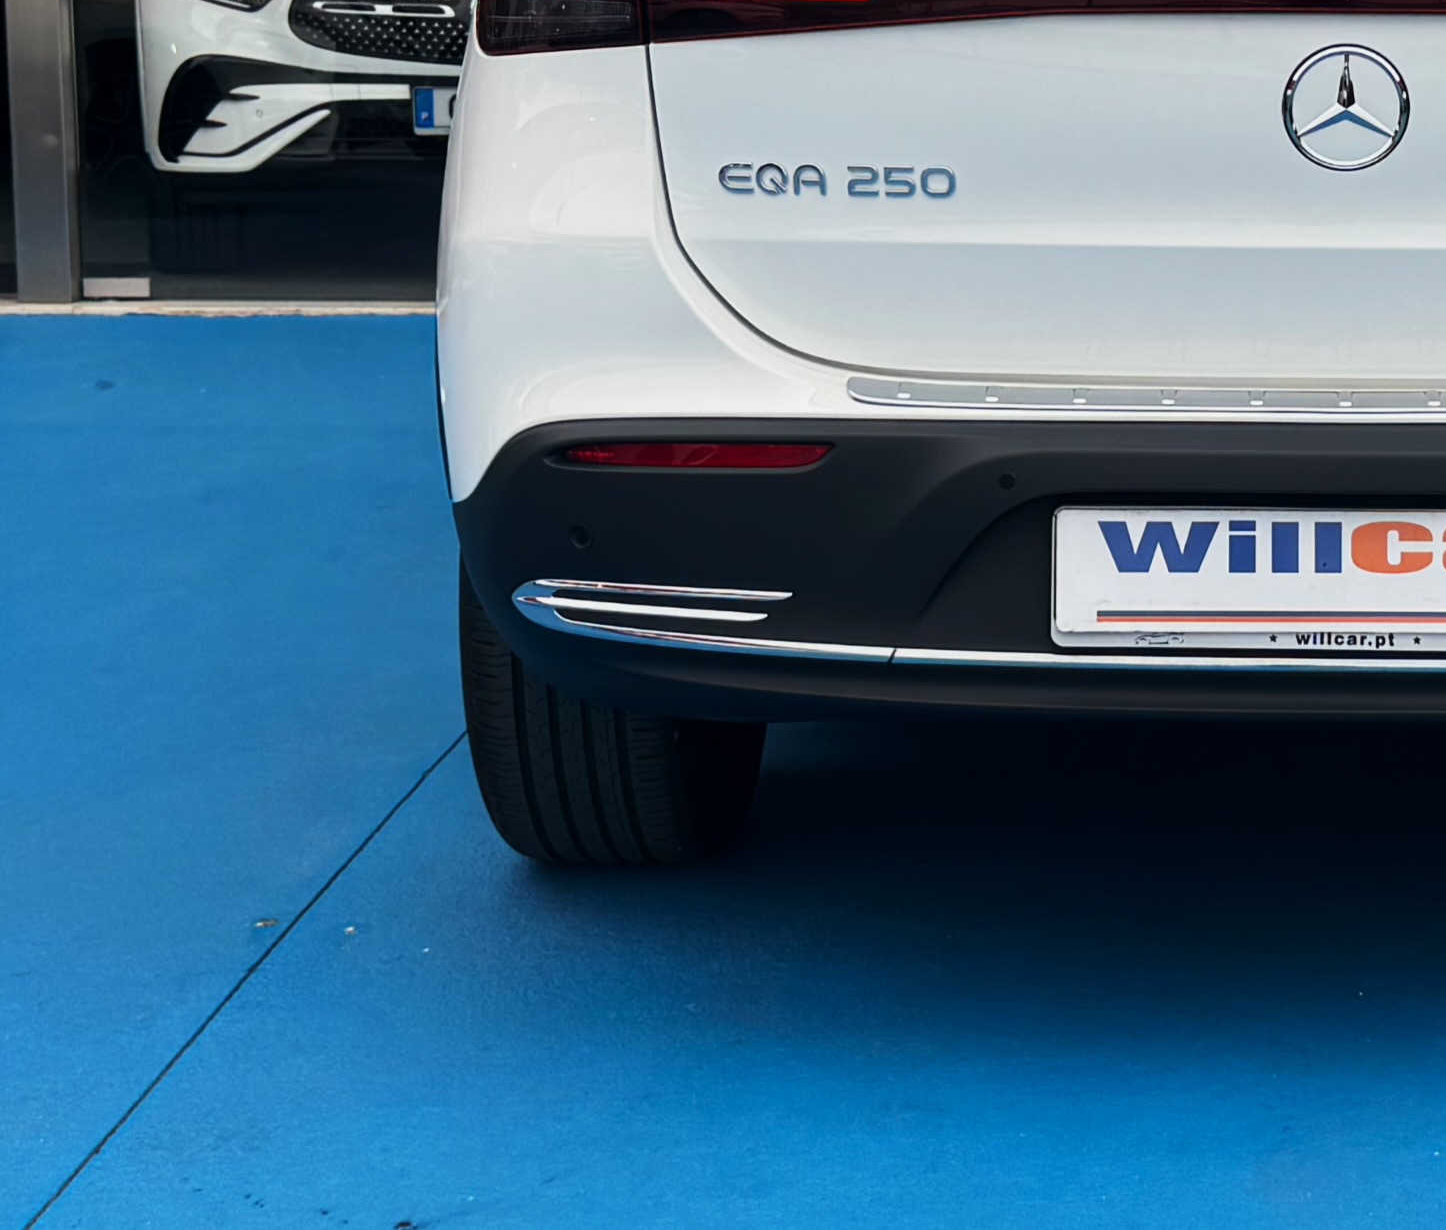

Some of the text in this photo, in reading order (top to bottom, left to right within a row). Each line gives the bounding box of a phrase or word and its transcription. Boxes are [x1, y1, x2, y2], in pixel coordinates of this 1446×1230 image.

[718, 162, 956, 198] EQA 250
[1295, 632, 1395, 649] willcar.pt
